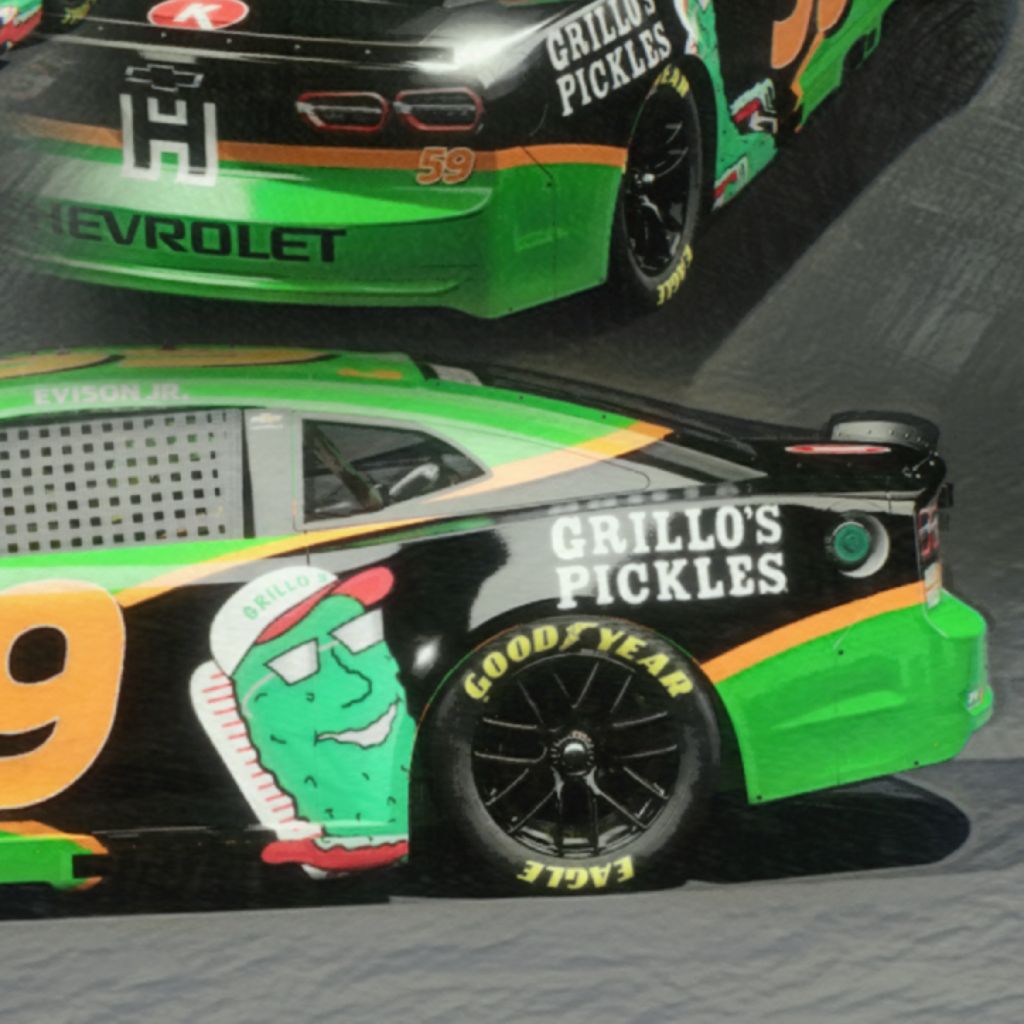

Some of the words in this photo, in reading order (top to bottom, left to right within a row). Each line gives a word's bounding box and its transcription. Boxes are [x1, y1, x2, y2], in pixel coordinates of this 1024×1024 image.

[556, 21, 673, 117] PICKLES
[416, 145, 476, 185] 59
[33, 384, 140, 407] EVISON
[550, 505, 782, 560] GRILLO'S
[556, 552, 789, 610] PICKLES
[517, 855, 636, 889] EAGLE
